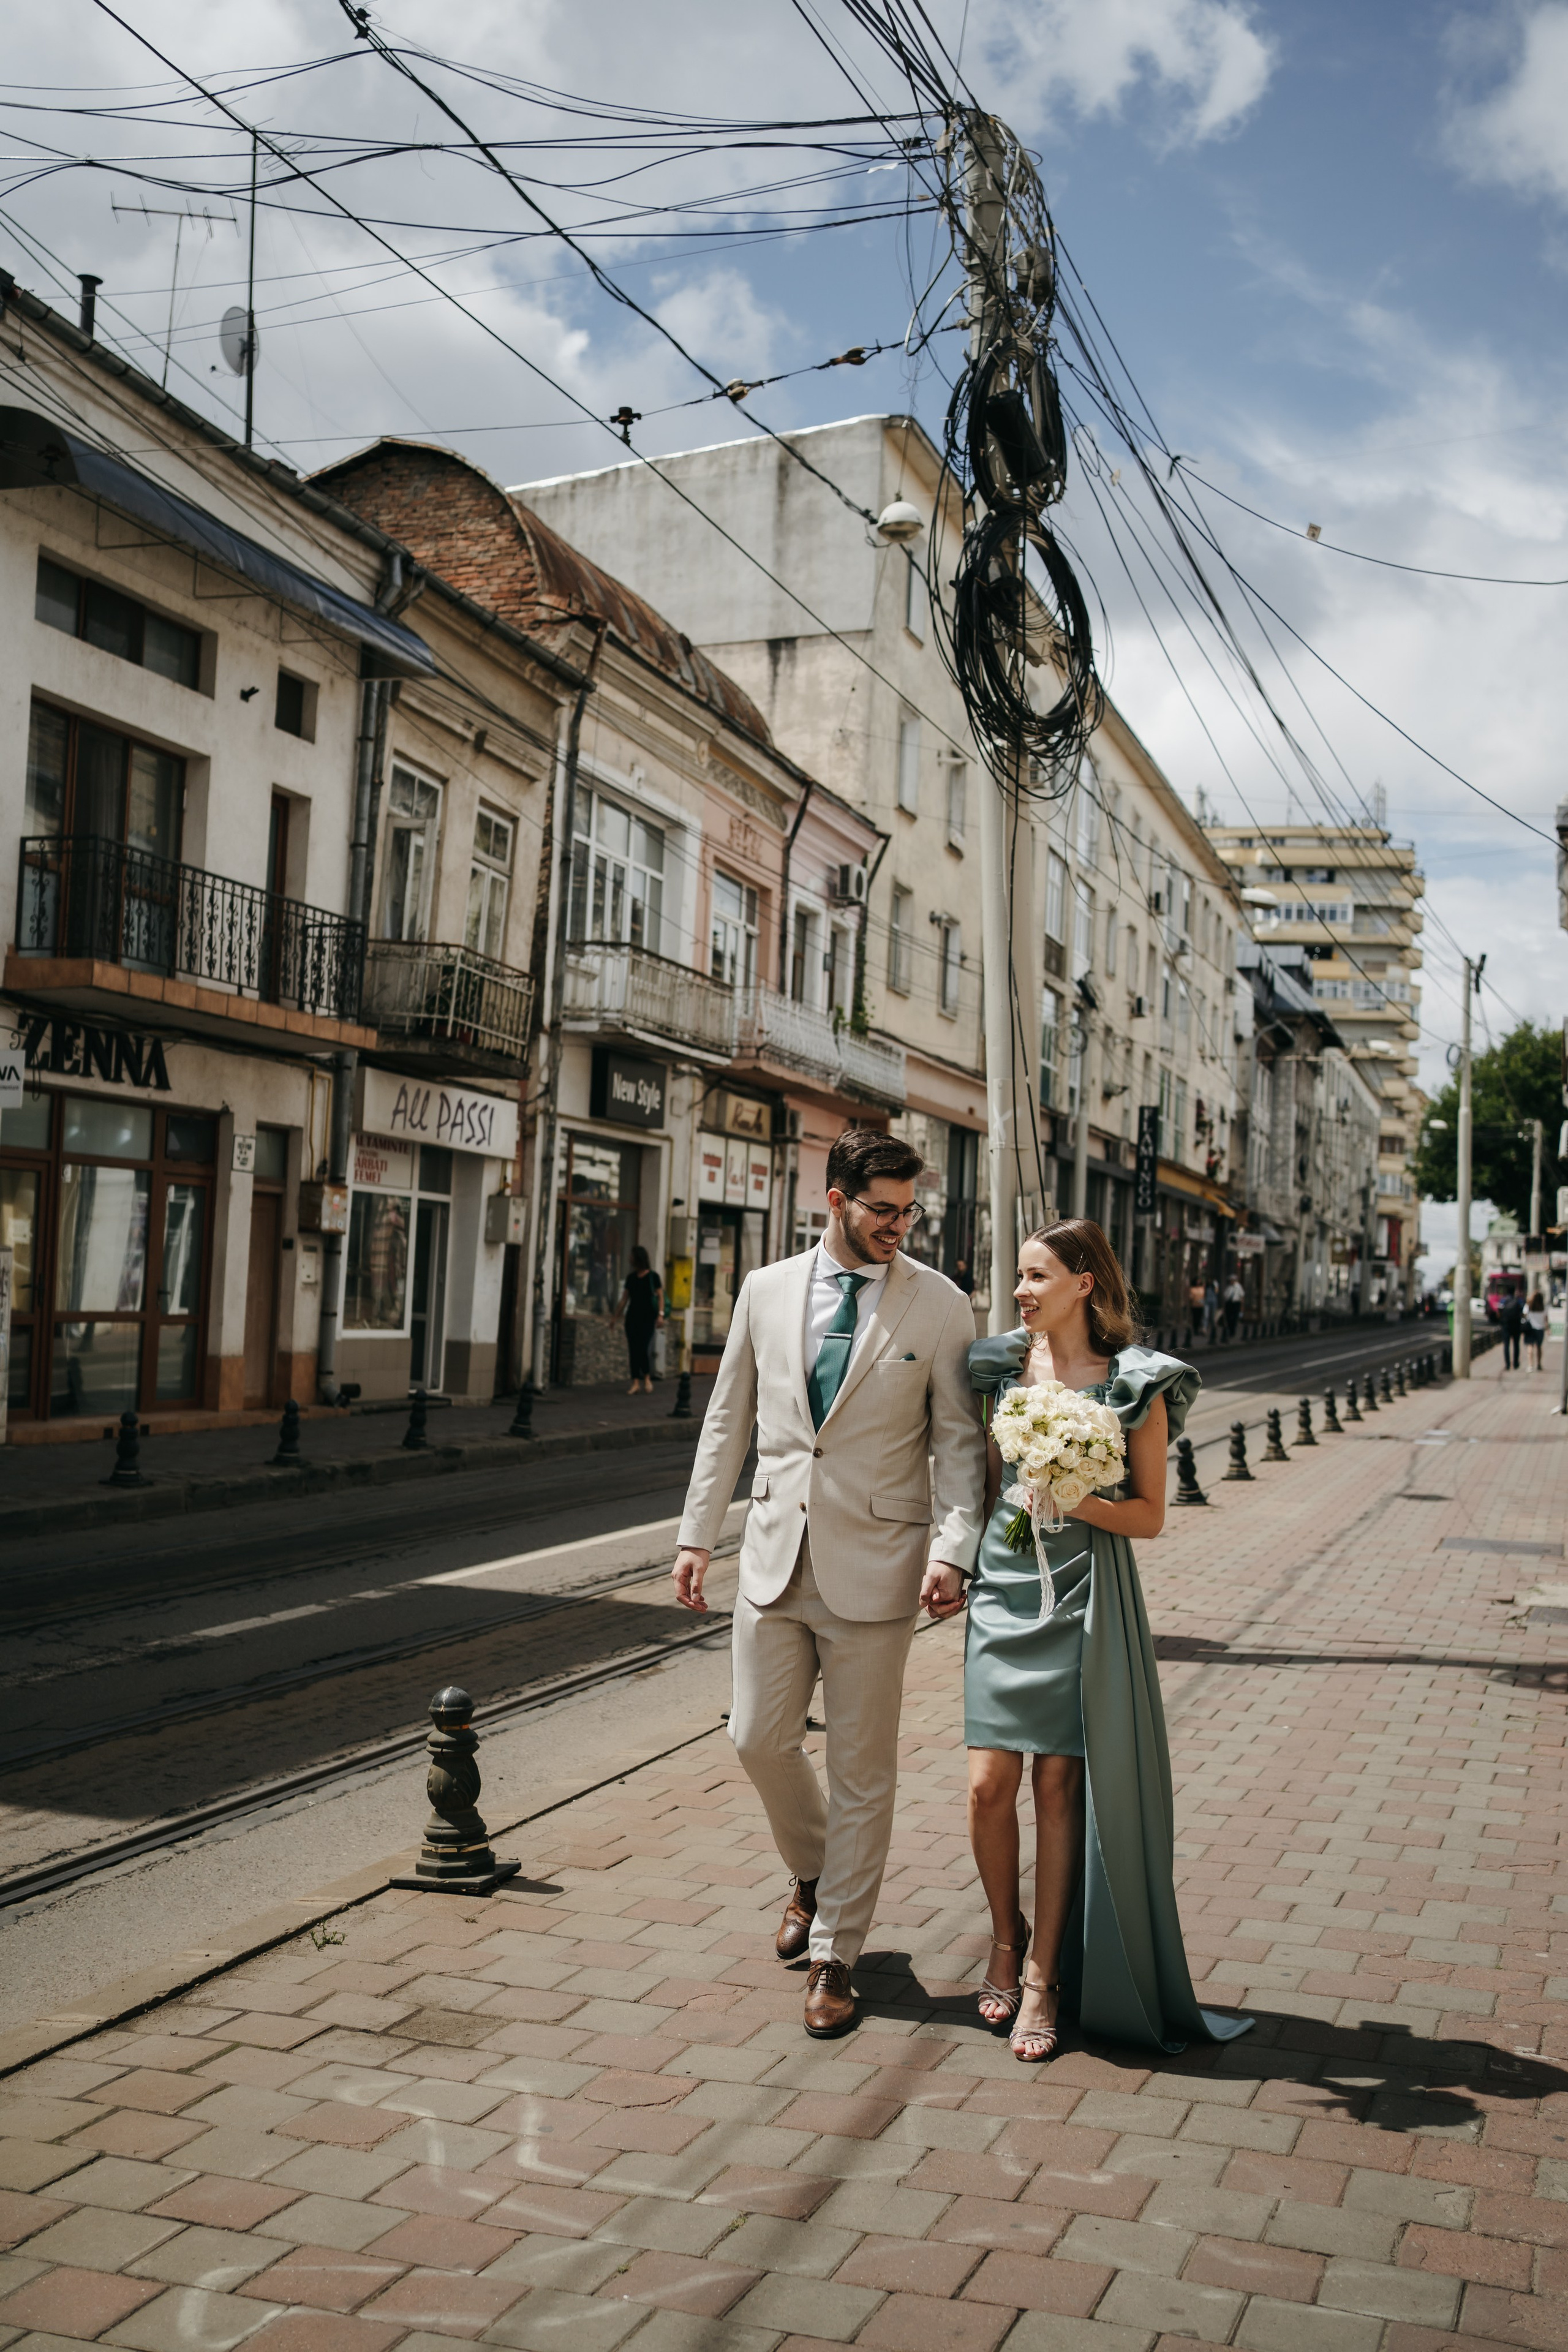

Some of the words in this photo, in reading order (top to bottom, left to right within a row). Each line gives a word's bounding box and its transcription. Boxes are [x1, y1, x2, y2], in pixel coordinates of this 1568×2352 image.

[18, 1014, 172, 1090] ZENNA
[612, 1072, 636, 1103] New
[637, 1079, 660, 1115] Style
[437, 1091, 494, 1147] PASSI
[354, 1169, 380, 1183] FEMEI
